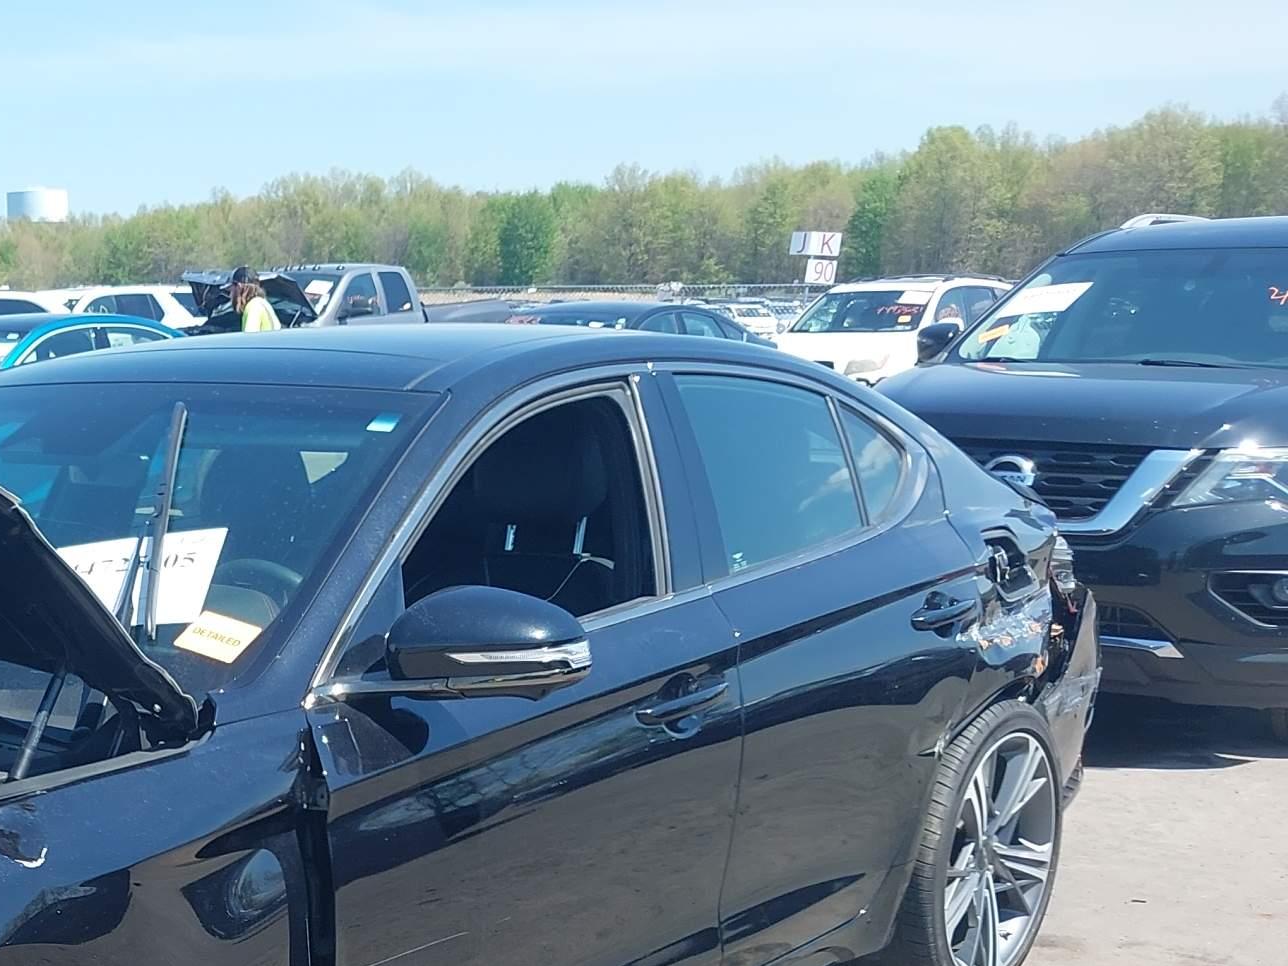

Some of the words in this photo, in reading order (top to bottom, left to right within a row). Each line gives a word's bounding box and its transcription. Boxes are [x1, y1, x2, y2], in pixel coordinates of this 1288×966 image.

[796, 232, 808, 254] J
[820, 233, 836, 255] K
[812, 261, 834, 283] 90
[192, 626, 241, 648] DETAILED
